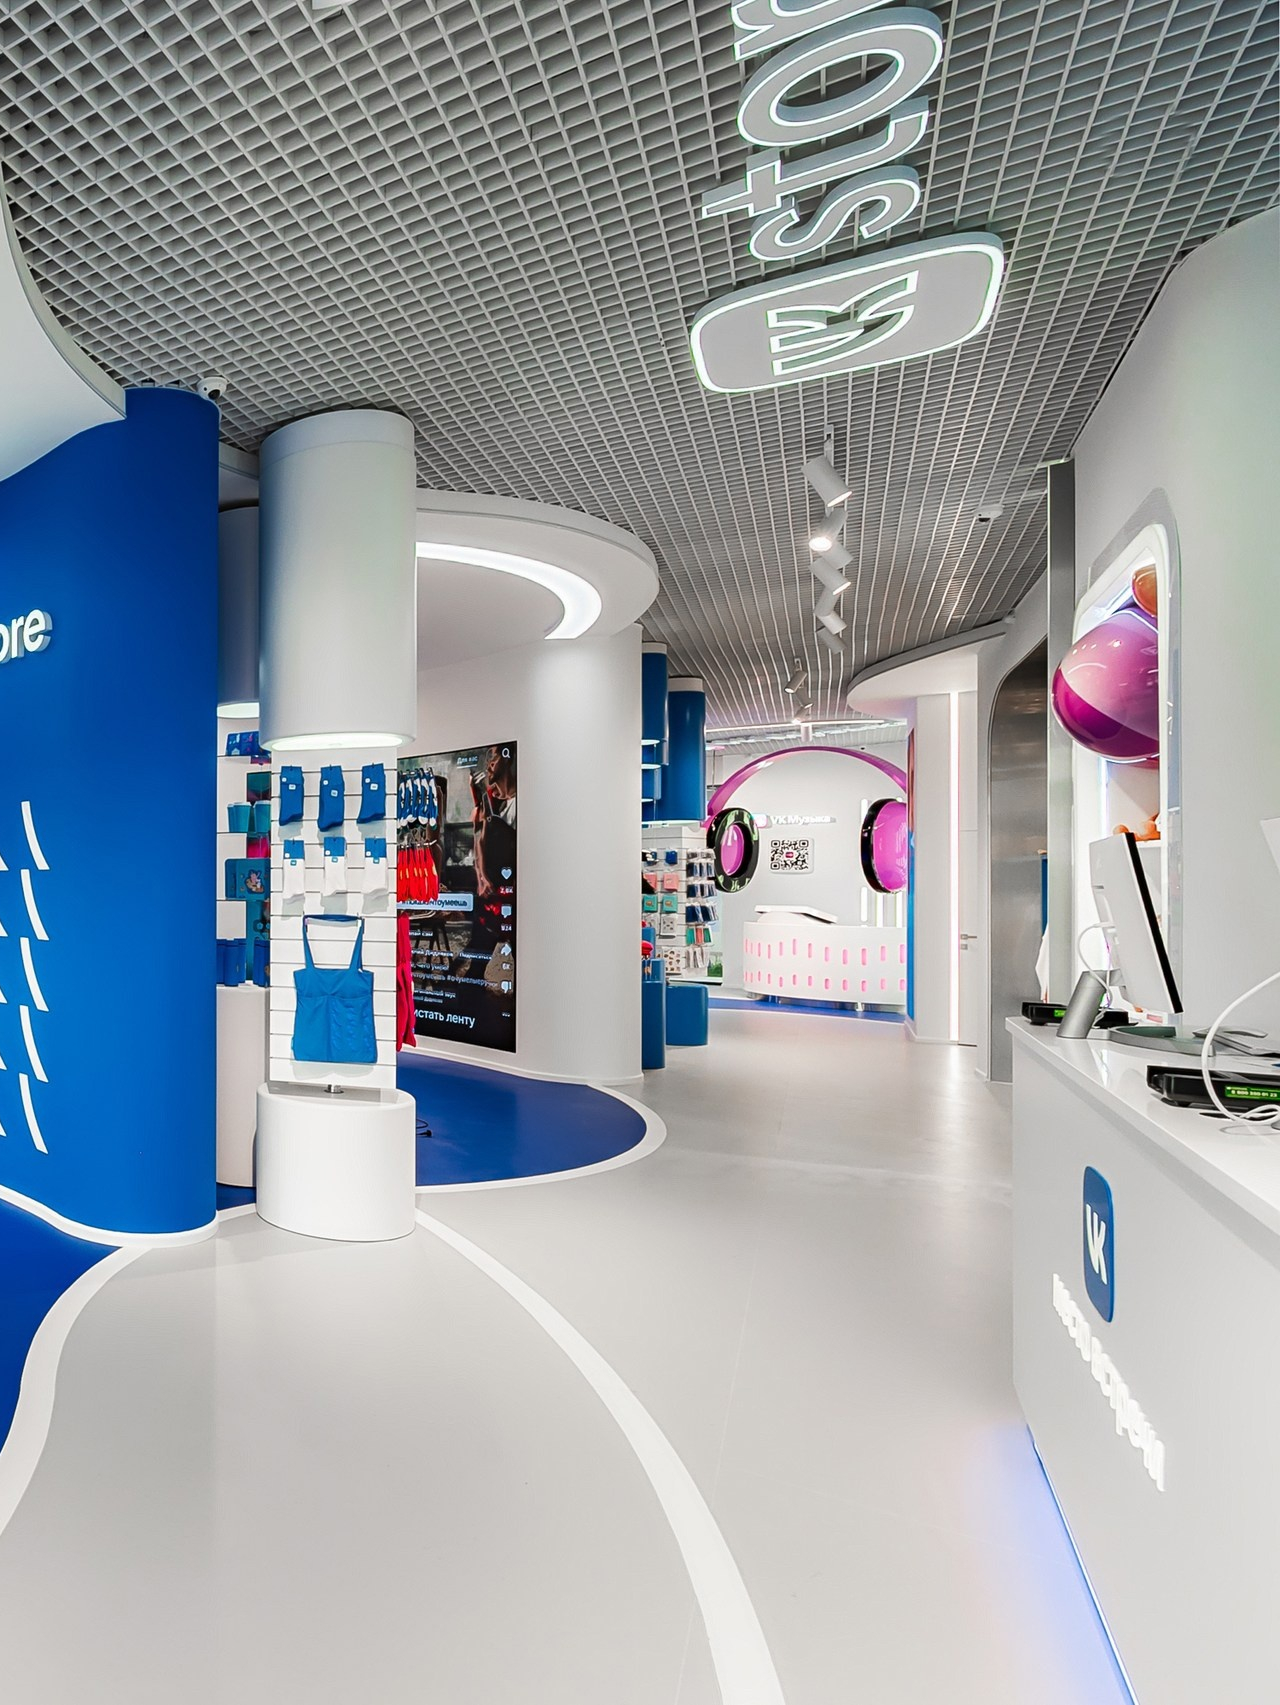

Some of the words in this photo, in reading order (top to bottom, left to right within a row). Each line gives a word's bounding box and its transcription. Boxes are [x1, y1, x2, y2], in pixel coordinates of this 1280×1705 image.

[787, 815, 831, 826] Музыка
[413, 1008, 445, 1022] истать
[445, 1013, 476, 1029] ленту
